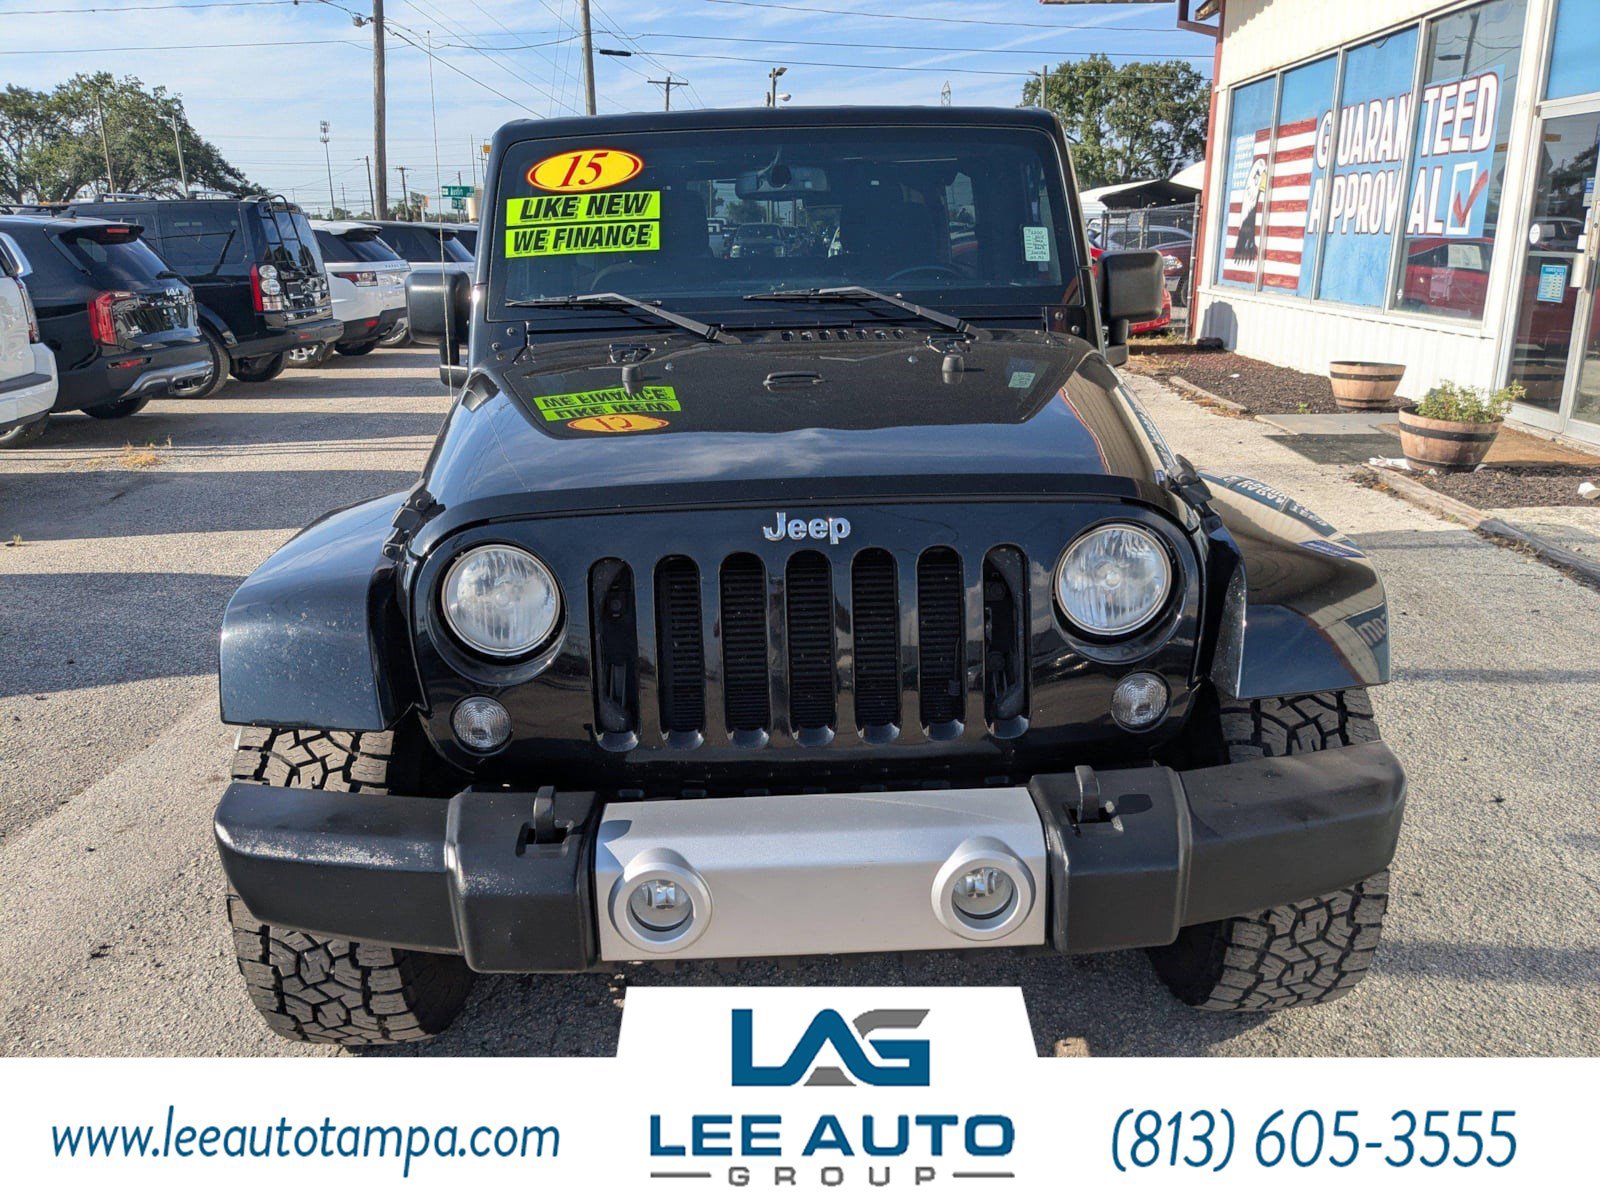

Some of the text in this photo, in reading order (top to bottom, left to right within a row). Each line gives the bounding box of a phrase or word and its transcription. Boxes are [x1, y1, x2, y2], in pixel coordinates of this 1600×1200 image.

[557, 152, 609, 188] 15
[519, 193, 651, 221] LIKE NEW
[513, 224, 653, 253] WE FINANCE
[763, 512, 851, 544] Jeep
